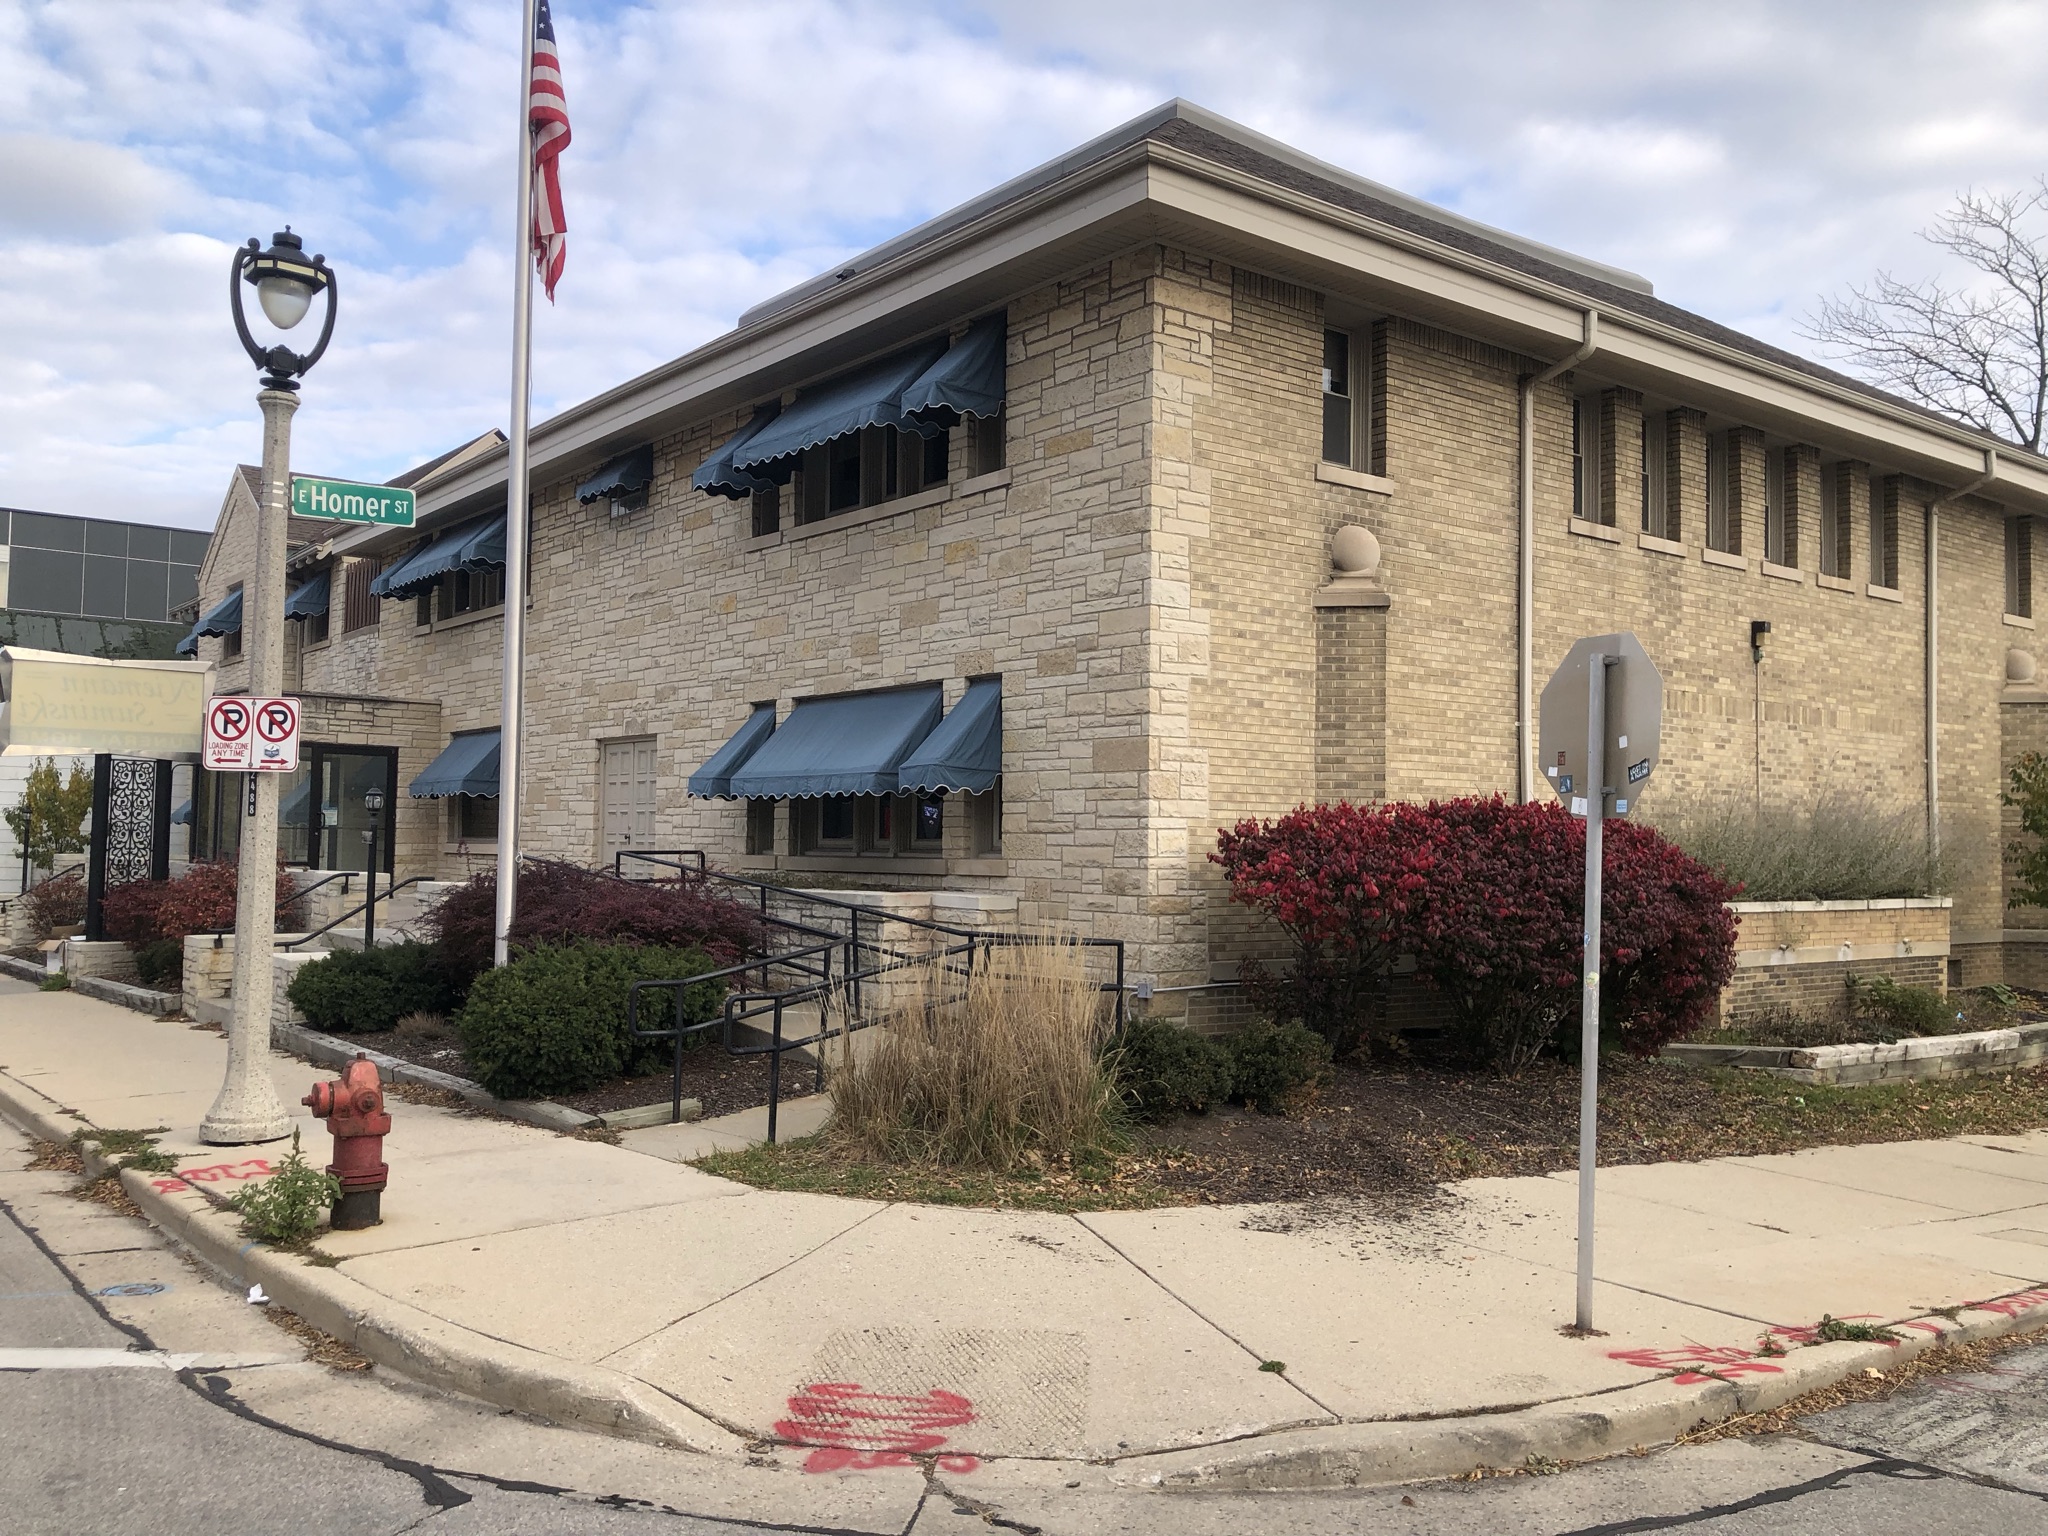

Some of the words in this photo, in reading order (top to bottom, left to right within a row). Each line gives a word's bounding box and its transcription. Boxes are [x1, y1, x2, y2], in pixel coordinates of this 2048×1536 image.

[299, 489, 307, 503] E
[311, 485, 391, 518] Homer
[394, 500, 409, 514] ST
[208, 742, 233, 750] LOADING
[234, 743, 249, 751] ZONE
[229, 750, 245, 758] TIME
